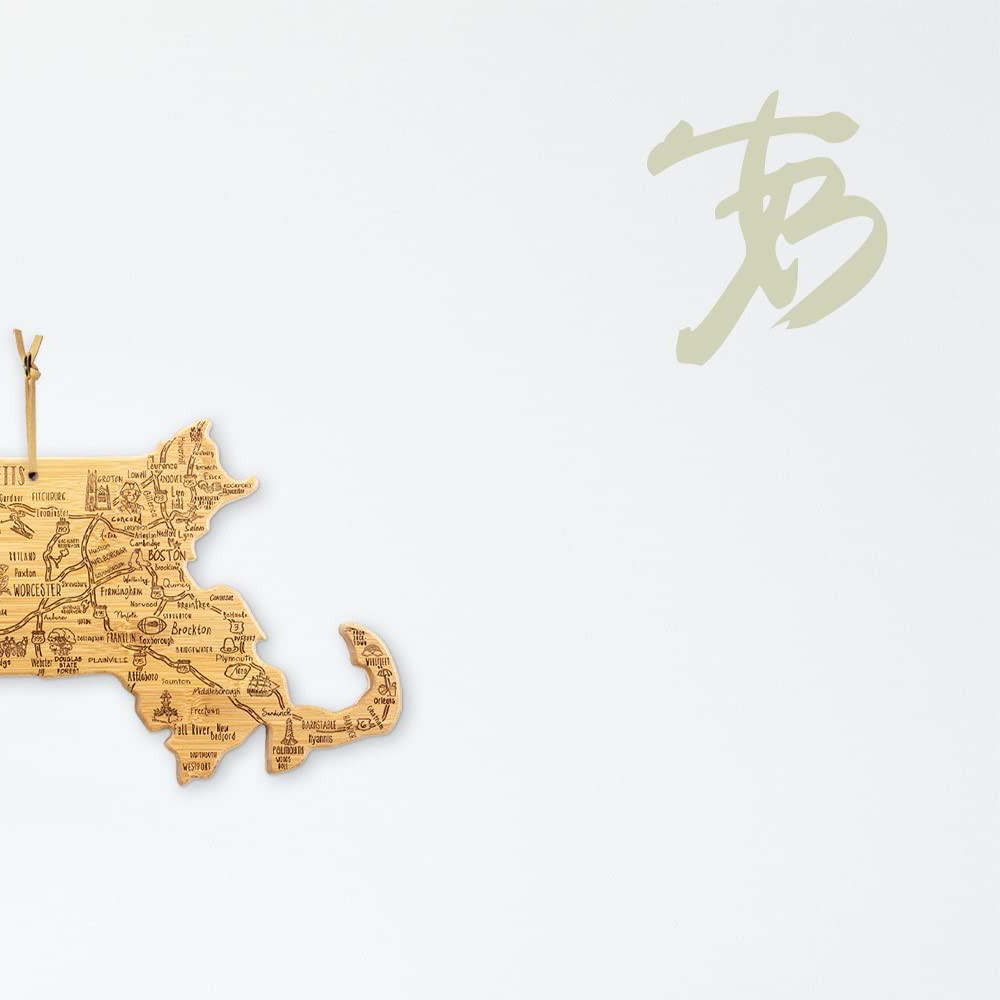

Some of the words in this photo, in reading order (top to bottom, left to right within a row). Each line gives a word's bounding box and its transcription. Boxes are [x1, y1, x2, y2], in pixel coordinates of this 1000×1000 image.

[97, 475, 123, 483] GROTON
[127, 470, 146, 479] Lowell
[0, 494, 23, 503] Gardner
[31, 492, 66, 501] FITCHBURG
[112, 514, 142, 525] Concord
[130, 539, 160, 549] Cambridge
[9, 552, 36, 561] RUTLAND
[149, 549, 186, 561] BOSTON
[14, 568, 36, 577] Paxton
[163, 578, 191, 591] Quincy
[13, 583, 62, 597] WORCESTER
[101, 585, 143, 599] Framingham
[171, 621, 212, 635] Brockton
[106, 632, 136, 643] FRANKLIN
[215, 653, 254, 663] Plymouth
[192, 687, 241, 698] Middleborough
[191, 705, 220, 716] Freetown
[262, 707, 292, 717] Sandwich
[216, 723, 229, 732] New
[302, 720, 336, 730] BARNSTABLE
[360, 720, 367, 729] 6
[173, 724, 188, 736] Fall
[182, 762, 211, 771] WESTPORT
